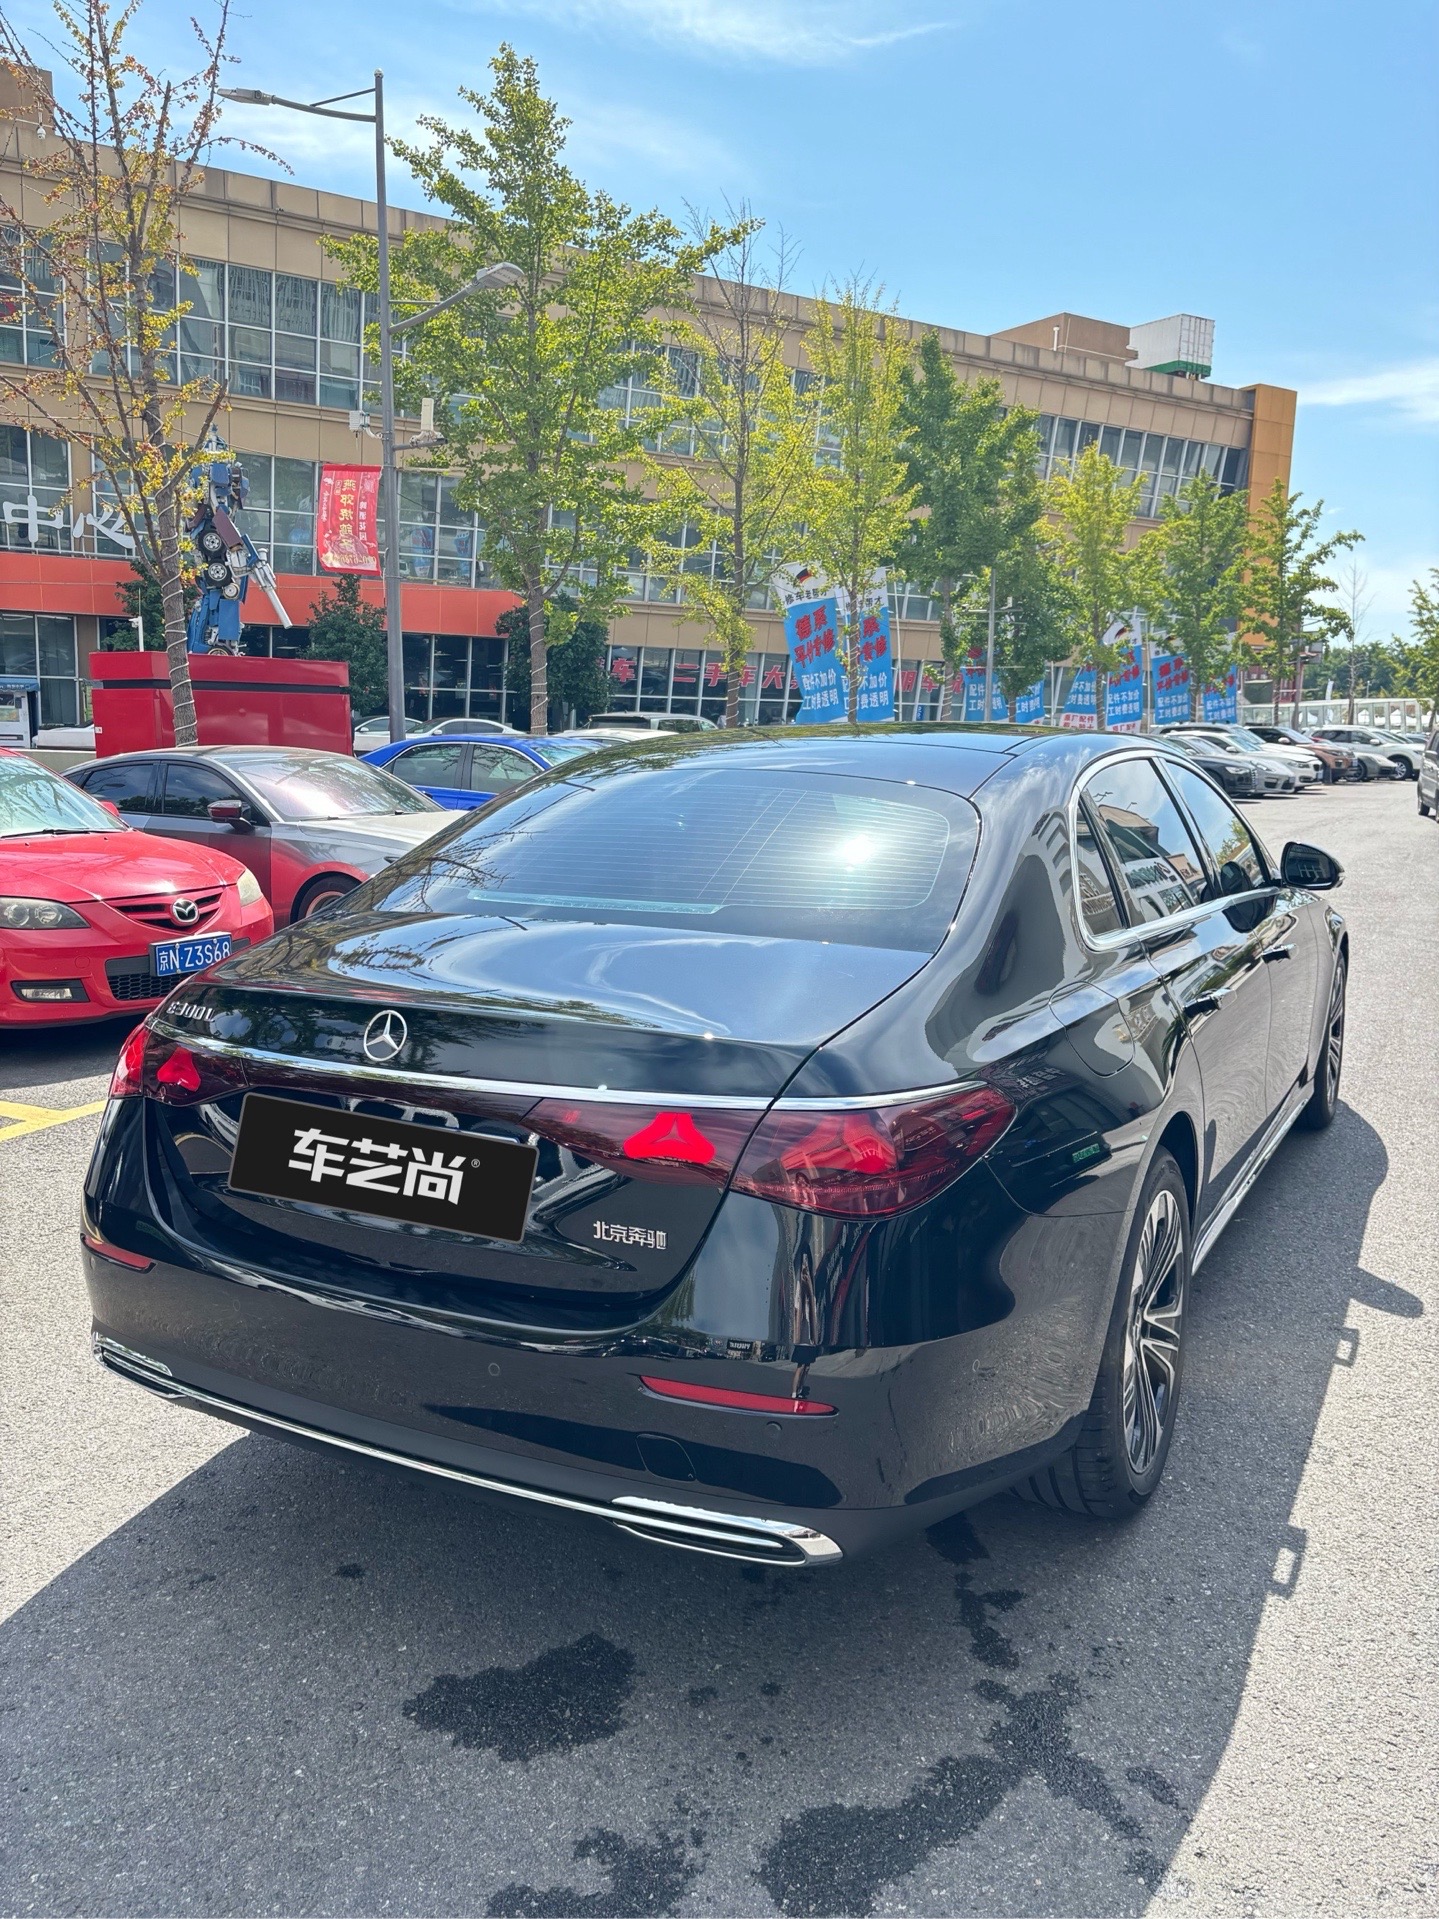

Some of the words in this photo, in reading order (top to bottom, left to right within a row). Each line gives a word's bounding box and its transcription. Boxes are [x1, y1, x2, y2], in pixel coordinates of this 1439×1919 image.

[2, 494, 143, 549] 中心
[593, 1220, 669, 1251] 北京奔驰
